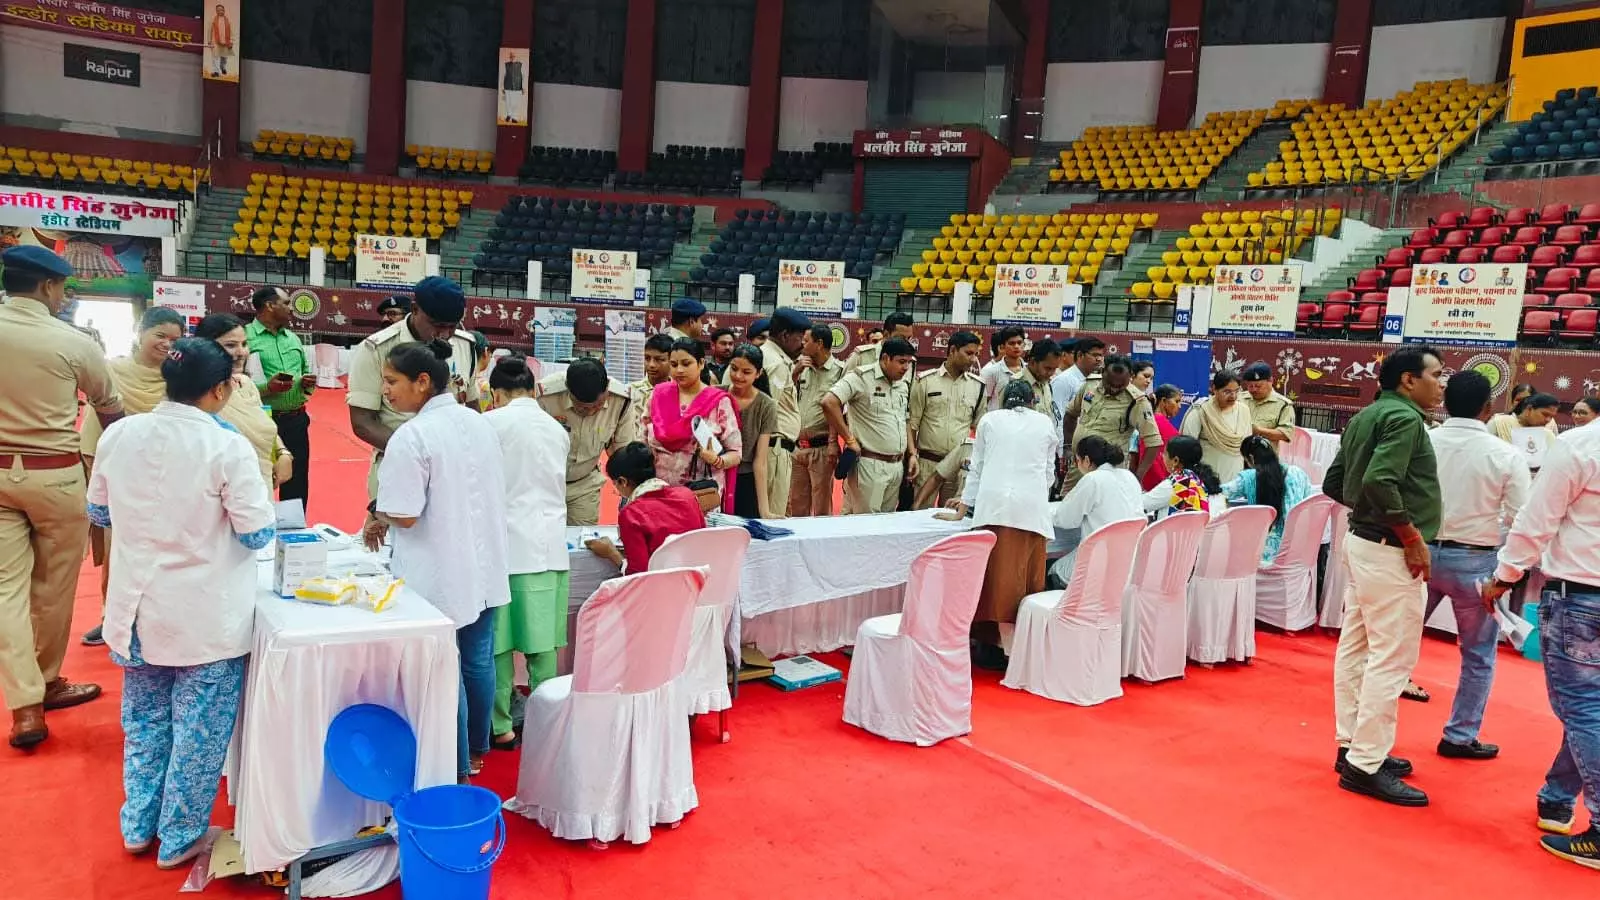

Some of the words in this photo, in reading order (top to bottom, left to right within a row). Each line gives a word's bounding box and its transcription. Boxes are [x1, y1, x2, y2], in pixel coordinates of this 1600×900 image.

[112, 5, 131, 18] सिंह
[137, 11, 167, 25] जुनेजा
[66, 11, 137, 36] स्टेडियम
[143, 25, 194, 48] रायपुर
[86, 58, 134, 79] Raipur
[904, 140, 927, 154] सिंह
[930, 139, 968, 156] जुनेजा
[62, 194, 107, 214] सिंह
[111, 201, 178, 221] जुनेजा
[41, 212, 70, 226] इंडोर
[75, 214, 122, 231] स्टेडियम
[635, 290, 645, 298] 02
[844, 301, 853, 309] 03
[1062, 309, 1073, 318] 04
[1177, 313, 1188, 323] 05
[1461, 308, 1474, 318] रोग
[1386, 319, 1400, 330] 06
